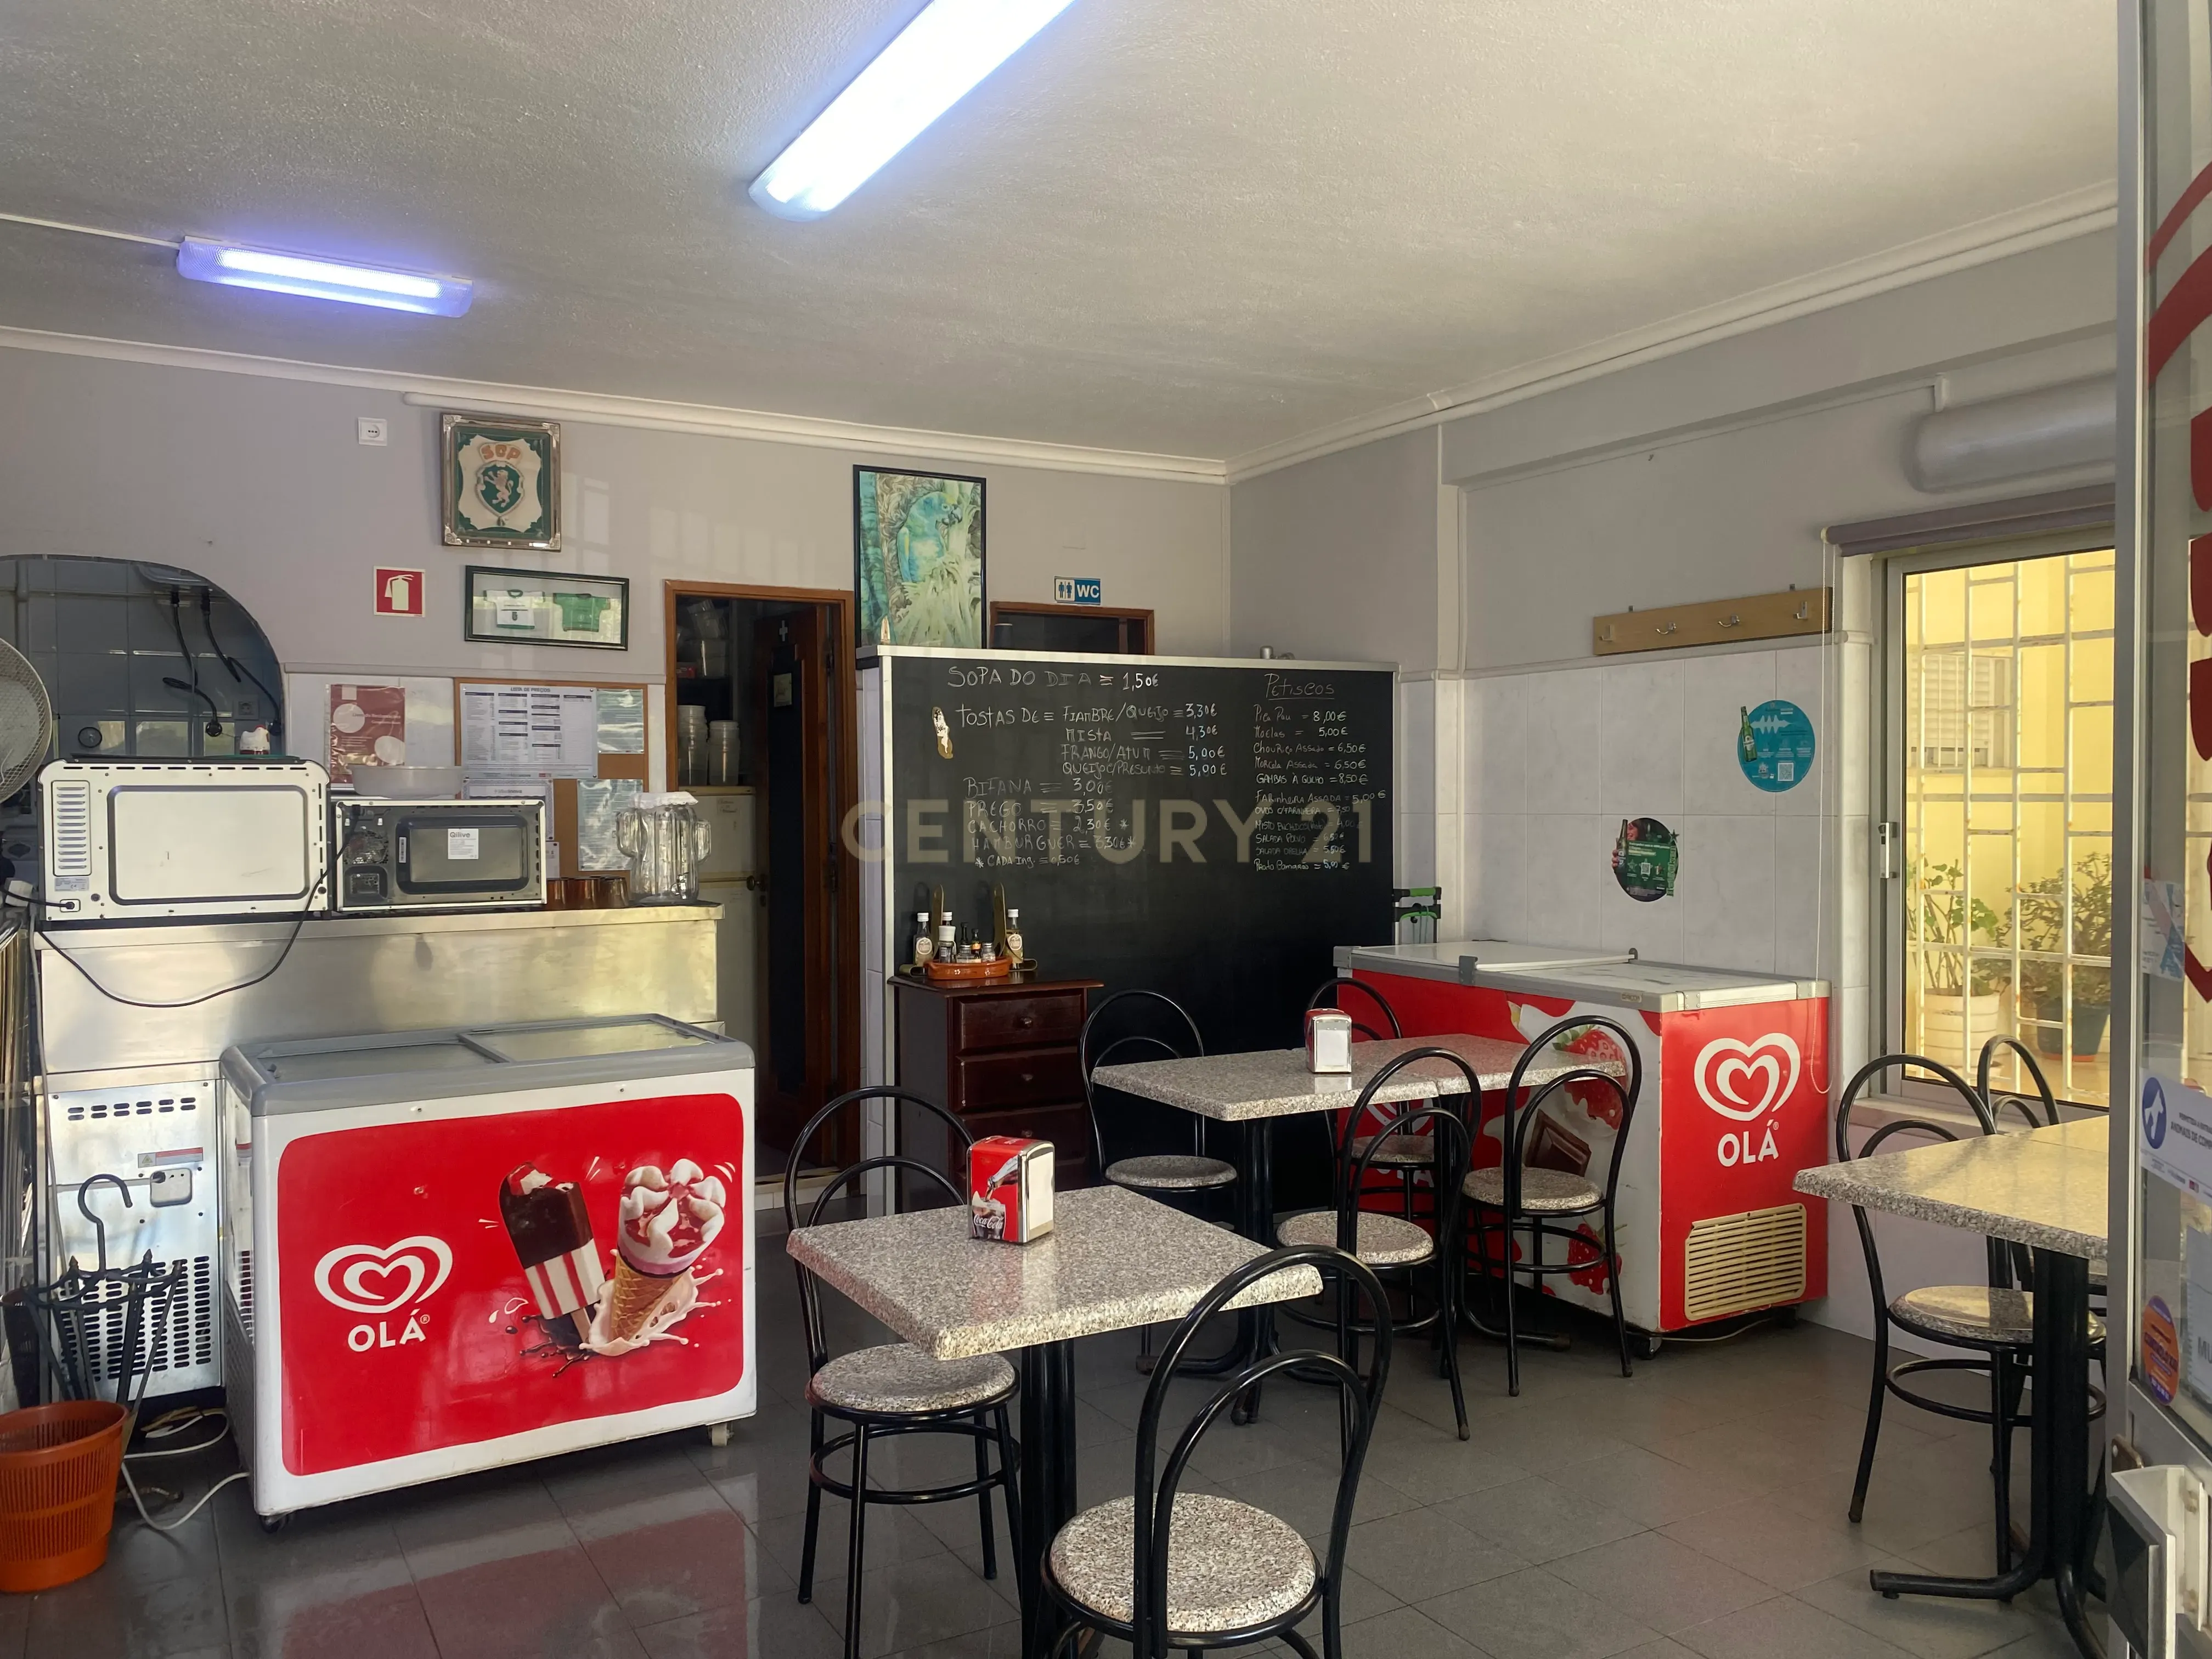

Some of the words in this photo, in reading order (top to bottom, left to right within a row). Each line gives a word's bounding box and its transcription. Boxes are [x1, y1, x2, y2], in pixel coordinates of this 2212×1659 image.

[1076, 584, 1099, 598] WC
[947, 666, 1002, 687] SOPA
[1009, 668, 1035, 686] DO
[1044, 671, 1092, 686] DIA
[1122, 672, 1159, 691] 1,50€
[1021, 707, 1040, 723] DE
[1185, 703, 1217, 719] 3,30€
[1065, 727, 1111, 742] MISTA
[1185, 725, 1218, 741] 4,30€
[1188, 745, 1225, 761] 5,00€
[963, 777, 1032, 799] BIFANA
[1073, 777, 1113, 796] 3,00€
[964, 799, 1023, 819] PREGO
[967, 818, 1046, 834] CACHORRO
[972, 834, 1074, 850] HAMBURGUER
[988, 855, 1013, 867] CADA
[1717, 1119, 1779, 1167] OLÁ
[347, 1308, 427, 1353] OLÁ
